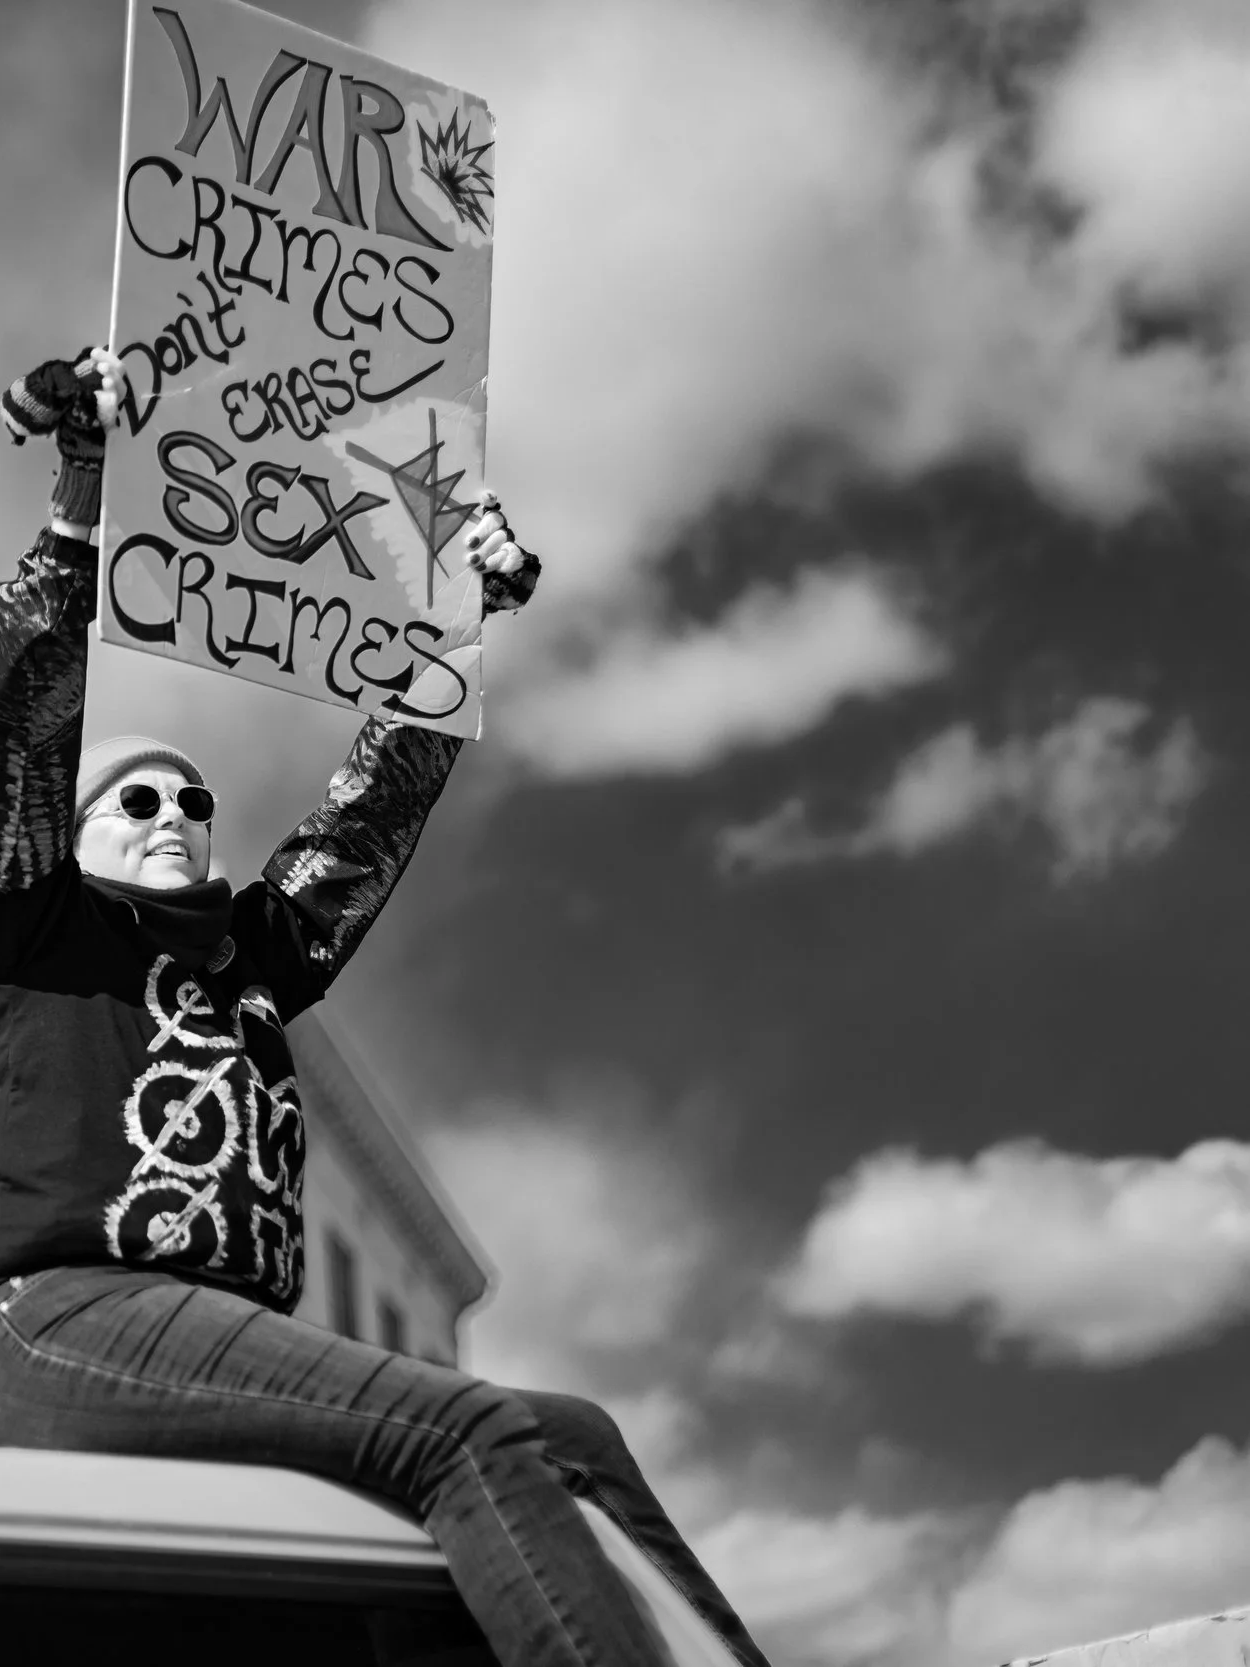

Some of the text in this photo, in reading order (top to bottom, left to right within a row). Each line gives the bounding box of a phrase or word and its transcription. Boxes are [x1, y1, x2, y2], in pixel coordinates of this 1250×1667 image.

[152, 6, 454, 252] WAR
[124, 155, 455, 345] CRIMES
[118, 271, 445, 442] Don't ERASE
[157, 430, 390, 581] SEX
[108, 533, 467, 720] CRIMES
